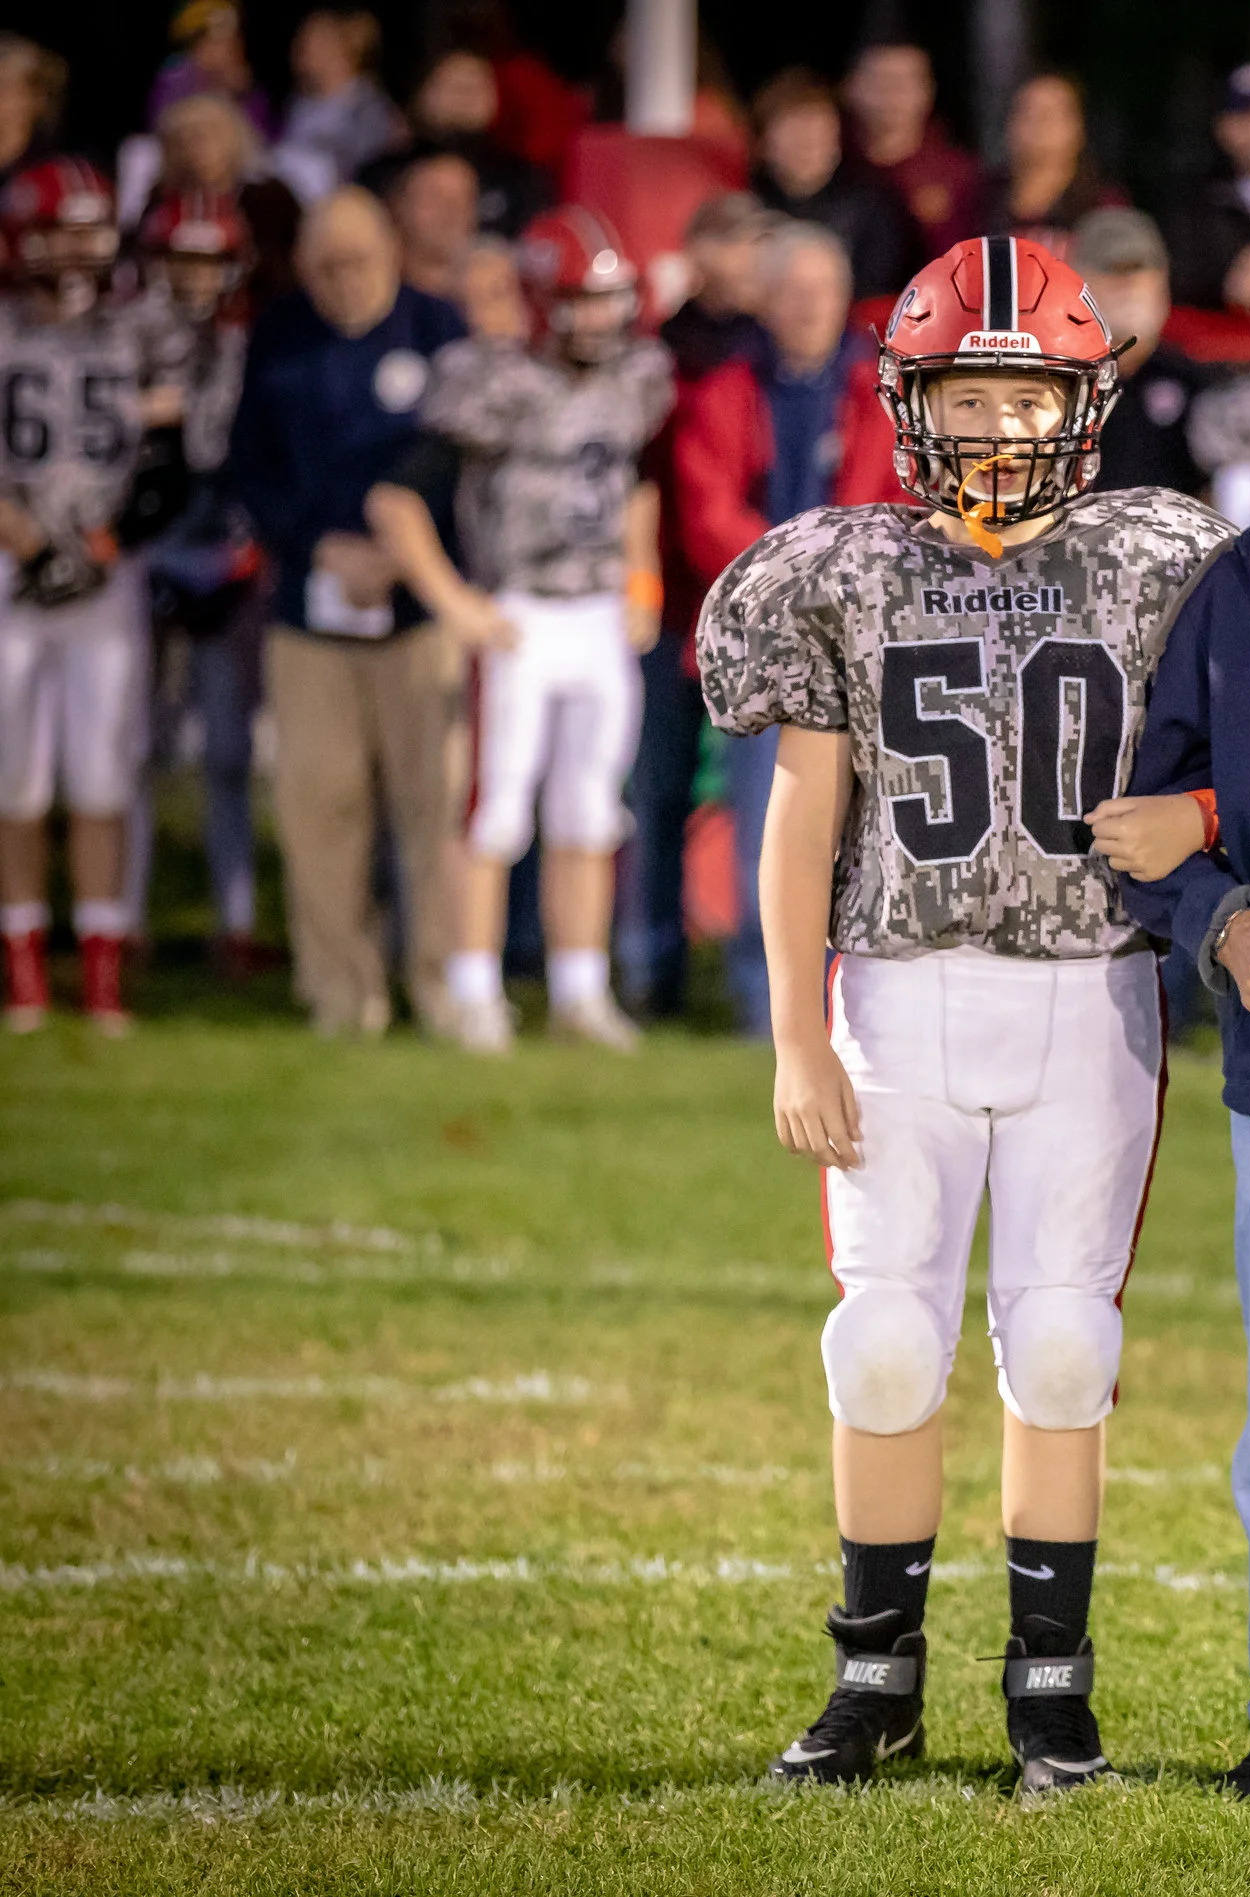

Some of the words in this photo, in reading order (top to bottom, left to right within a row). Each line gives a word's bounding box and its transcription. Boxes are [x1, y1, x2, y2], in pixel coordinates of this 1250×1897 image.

[969, 335, 1030, 349] Riddell
[3, 365, 132, 464] 65
[921, 586, 1064, 616] Riddell
[879, 637, 1128, 866] 50
[843, 1659, 891, 1685] NIKE
[1026, 1665, 1074, 1689] NIKE
